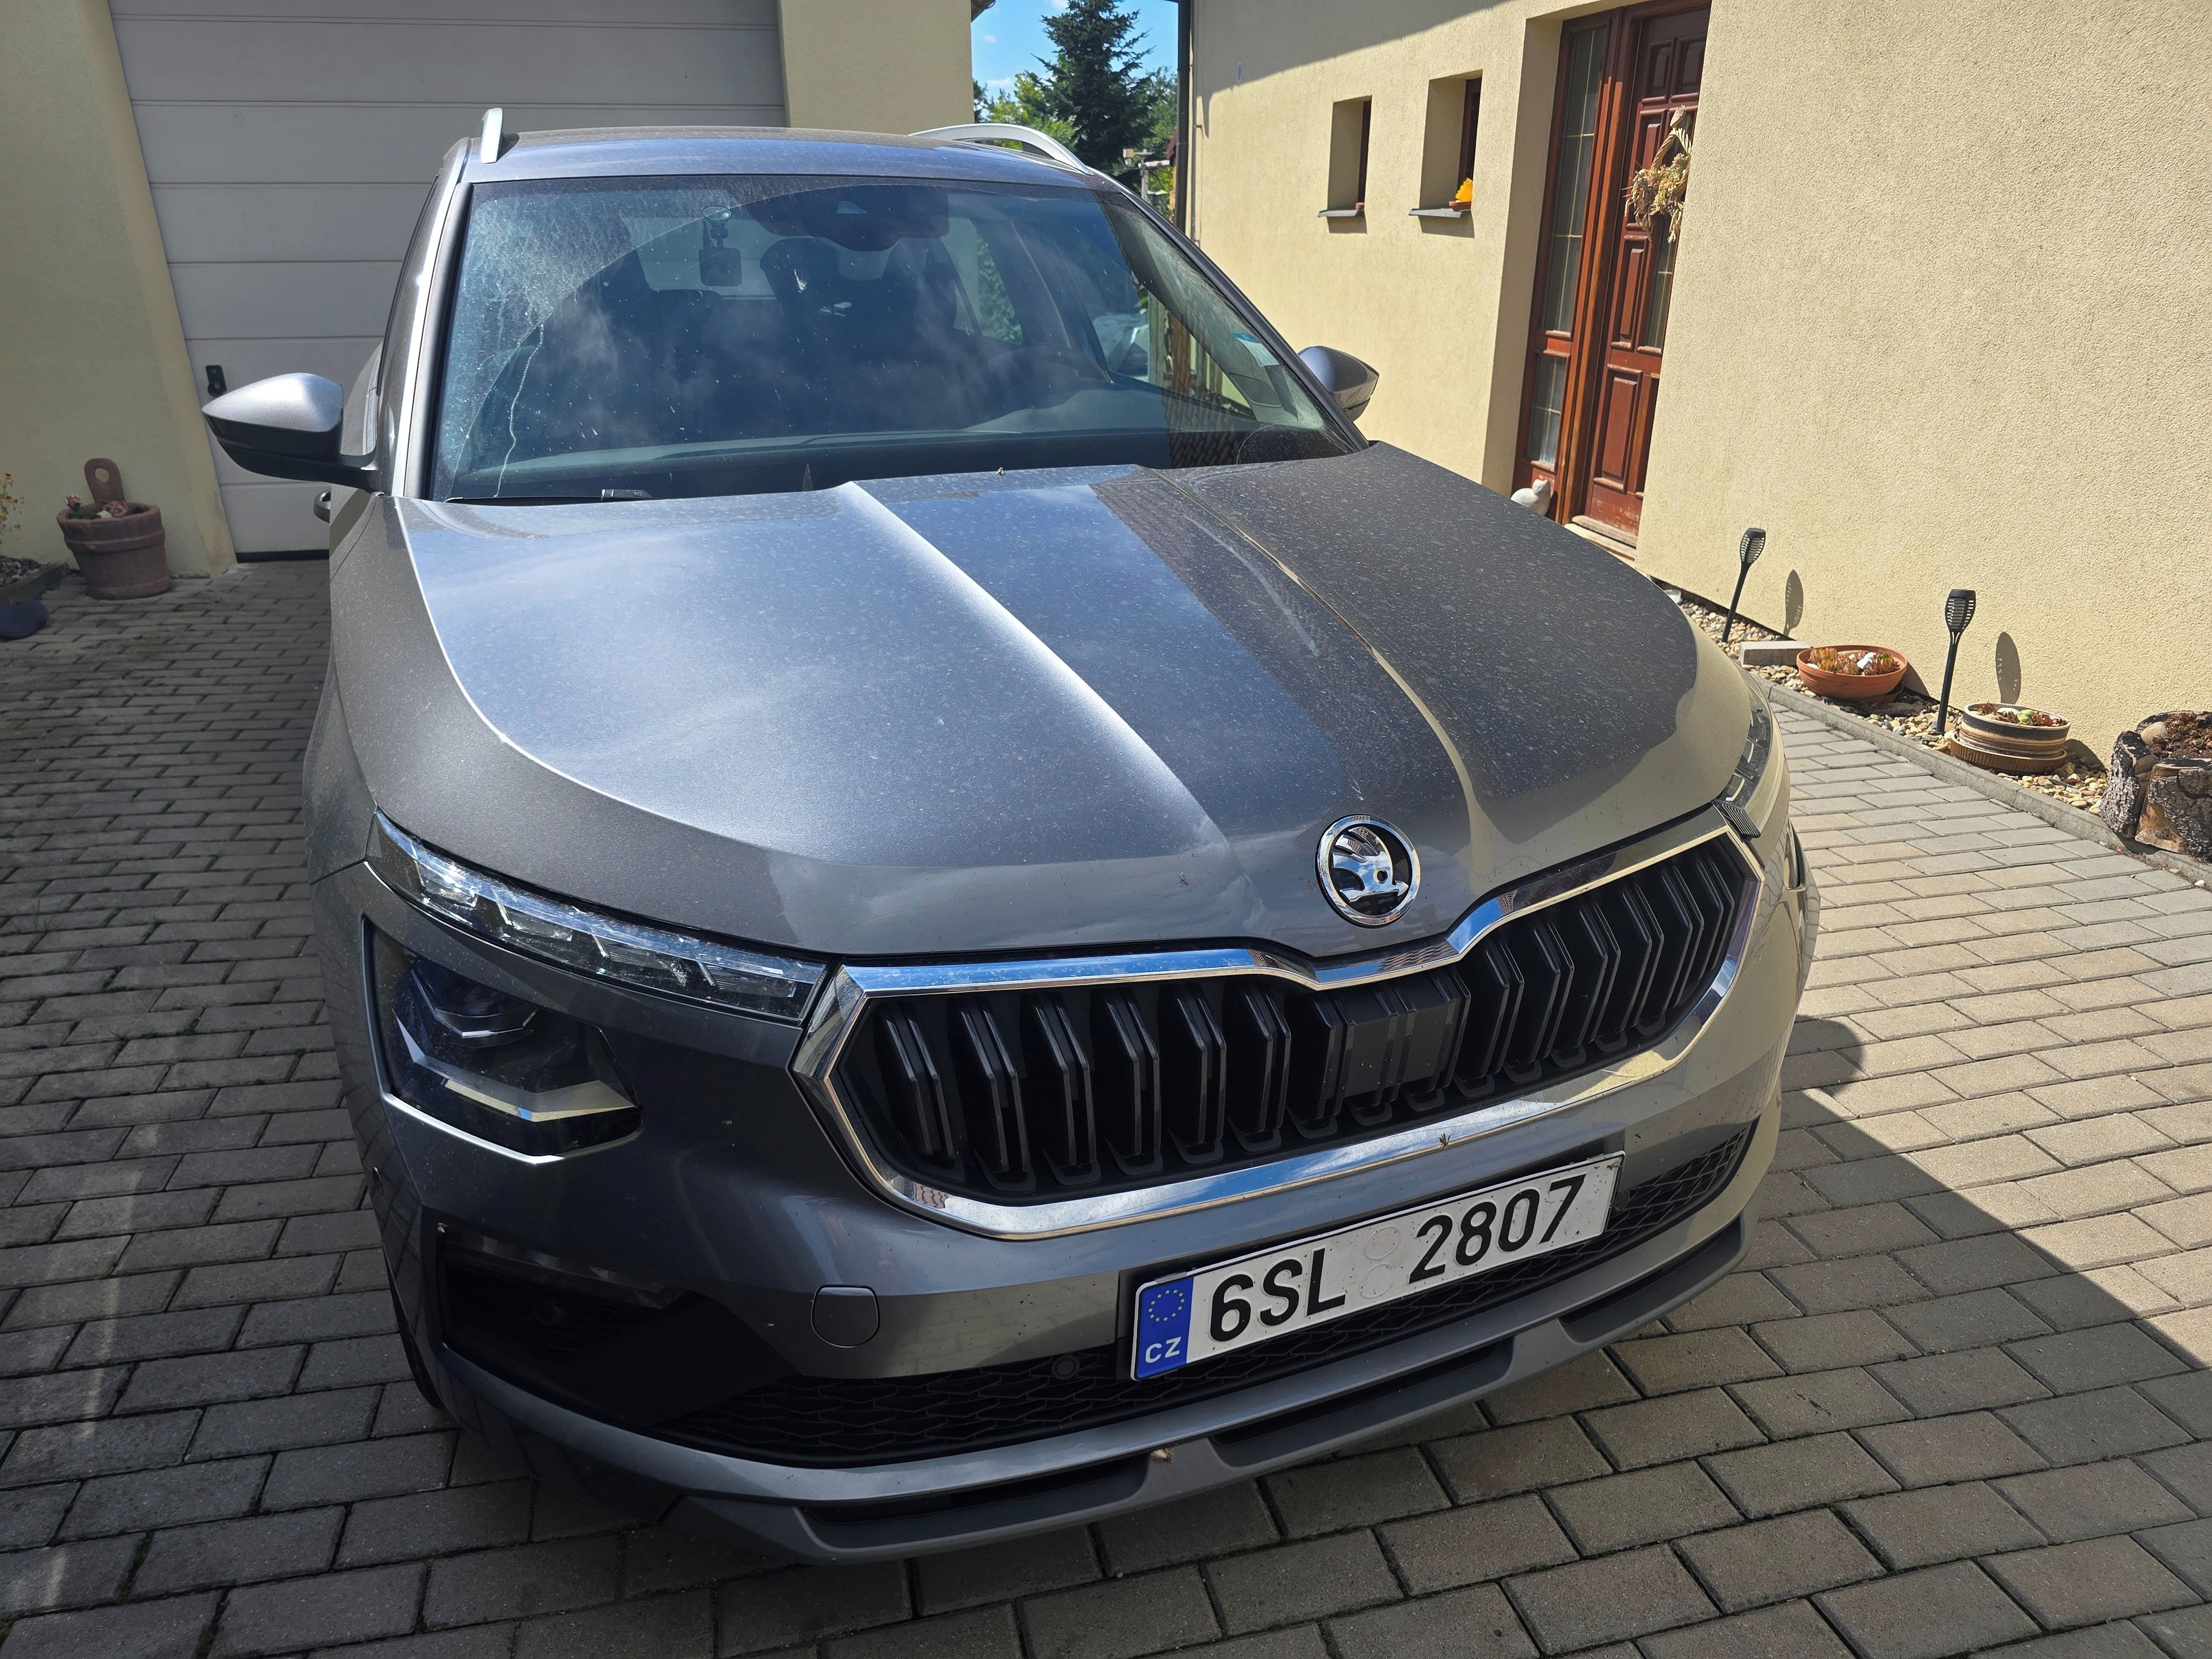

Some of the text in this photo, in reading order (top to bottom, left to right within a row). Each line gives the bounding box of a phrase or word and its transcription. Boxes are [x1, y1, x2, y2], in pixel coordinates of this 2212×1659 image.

[1211, 1173, 1587, 1342] 6SL 2807
[1145, 1337, 1181, 1364] CZ
